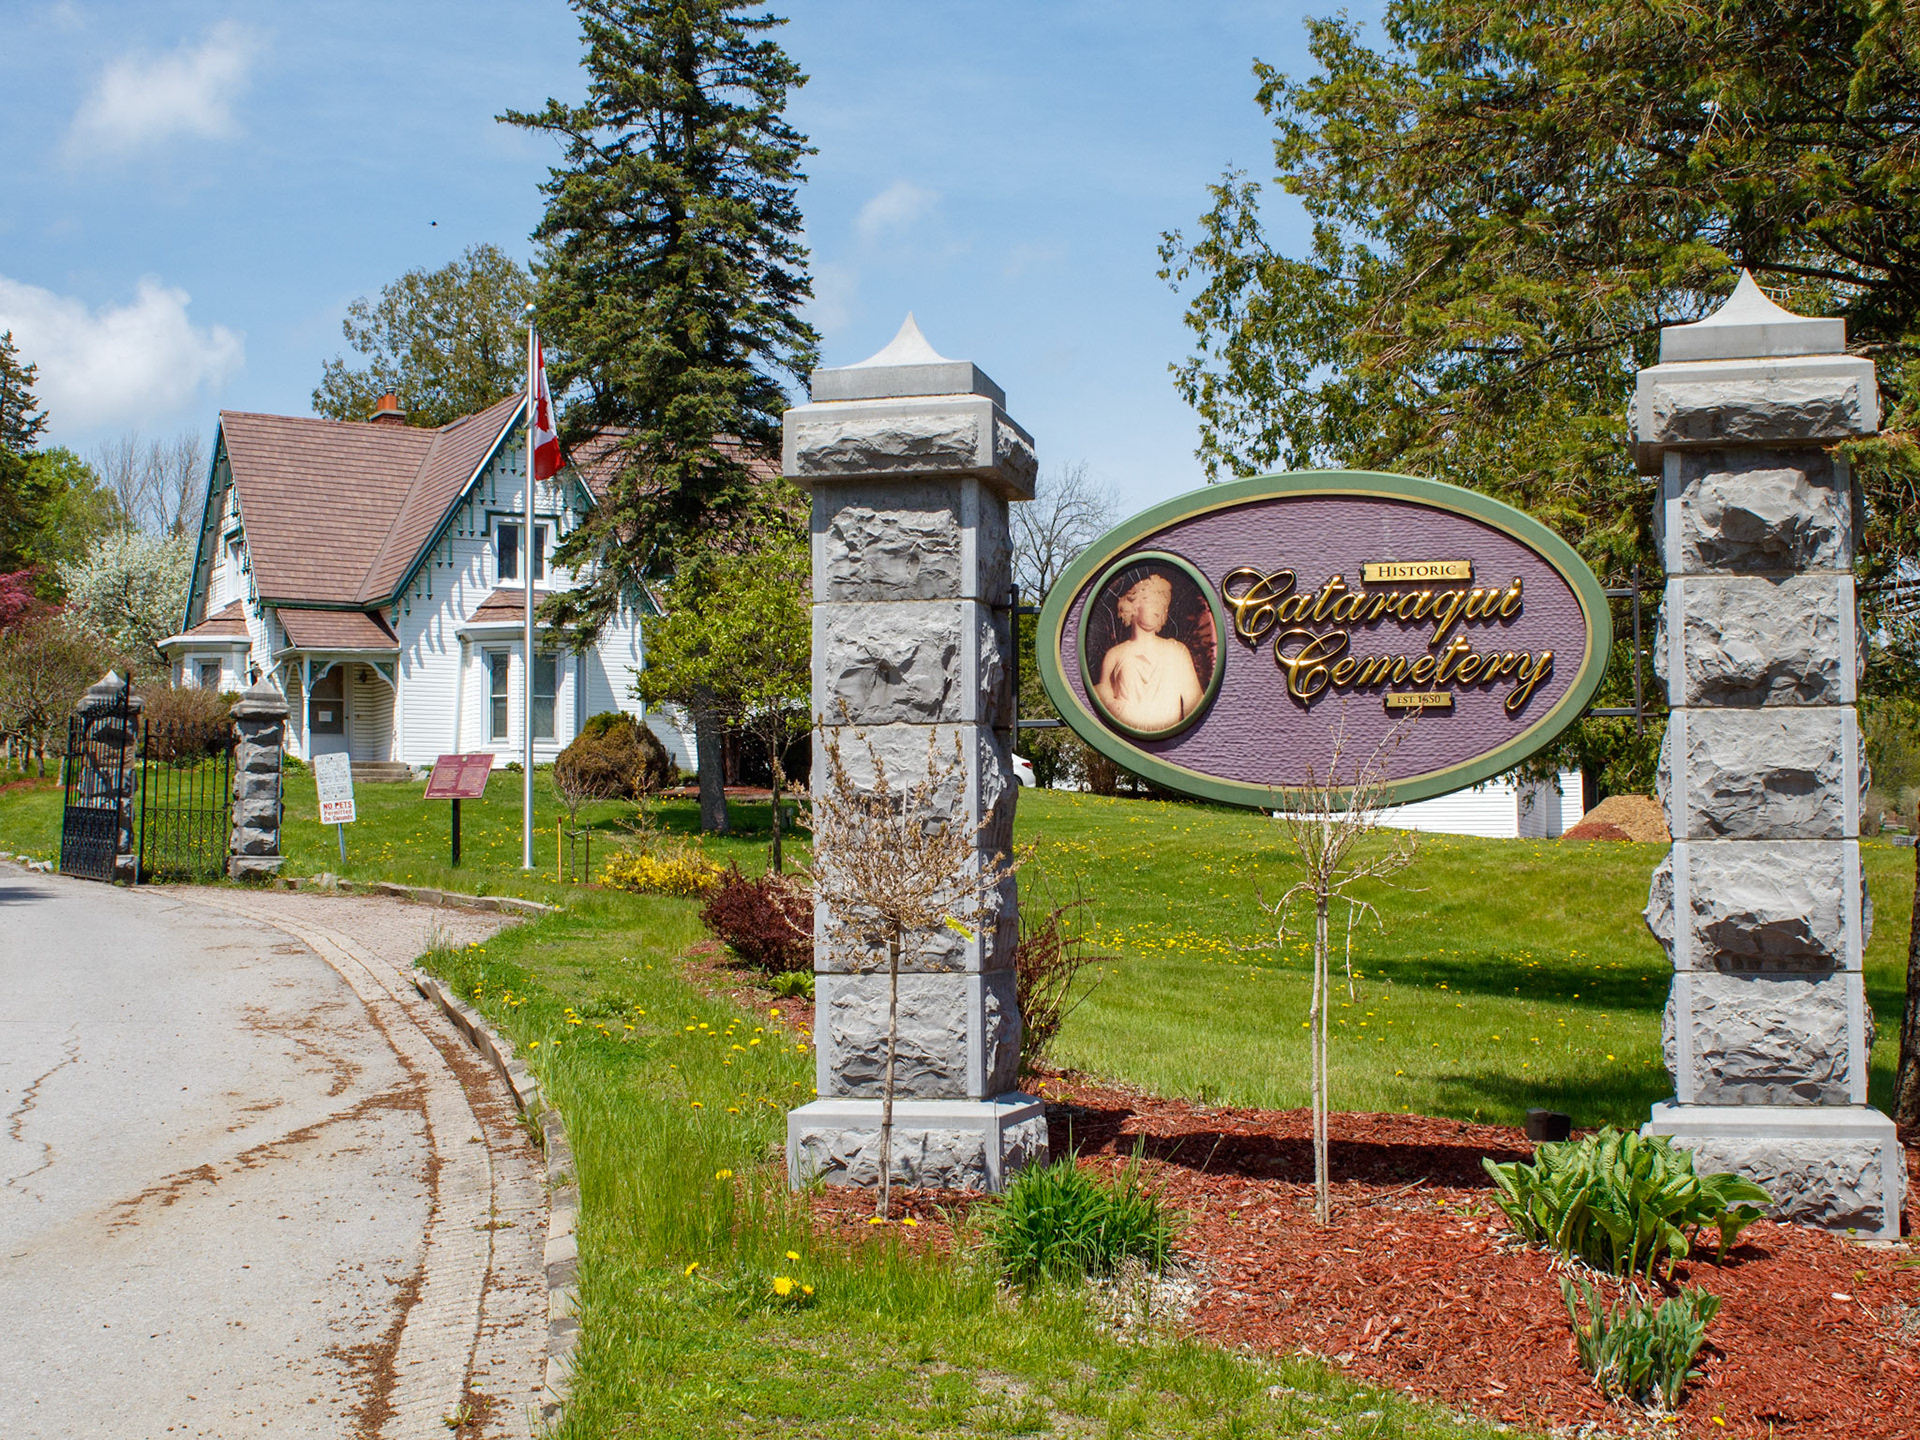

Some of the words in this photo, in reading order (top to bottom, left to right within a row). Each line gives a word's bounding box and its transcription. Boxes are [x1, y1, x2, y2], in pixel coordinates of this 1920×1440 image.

[1379, 565, 1457, 577] HISTORIC
[1222, 567, 1524, 647] Cataraqui
[1274, 628, 1553, 713] Cemetery
[335, 801, 352, 809] PETS
